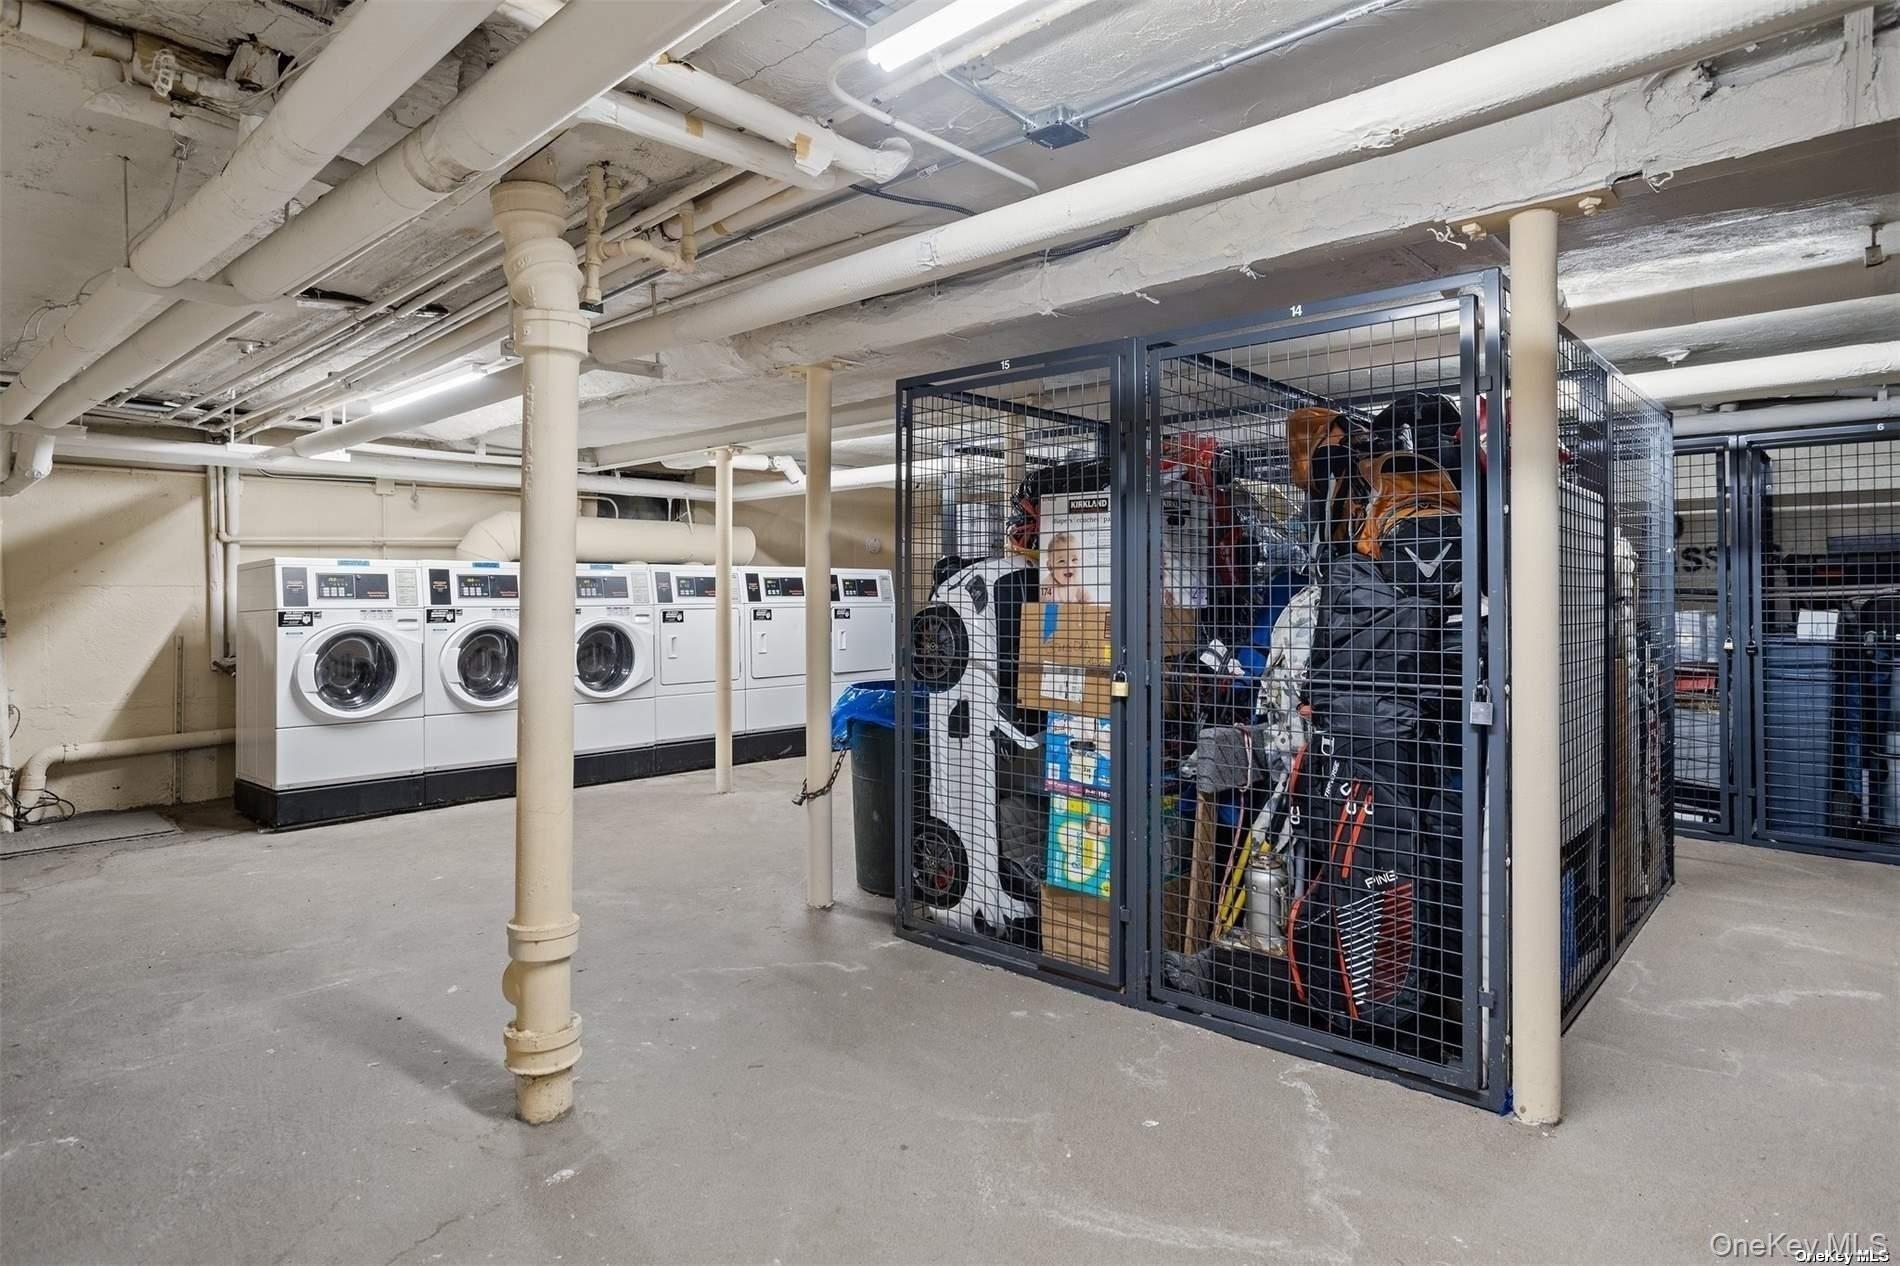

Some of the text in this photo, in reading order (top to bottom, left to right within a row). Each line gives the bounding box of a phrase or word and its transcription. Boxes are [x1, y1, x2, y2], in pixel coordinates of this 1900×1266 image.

[1290, 304, 1303, 317] 14
[1000, 360, 1010, 370] 15
[1877, 422, 1885, 431] 6
[1071, 500, 1107, 509] KIRKLAND
[1365, 869, 1397, 889] PING
